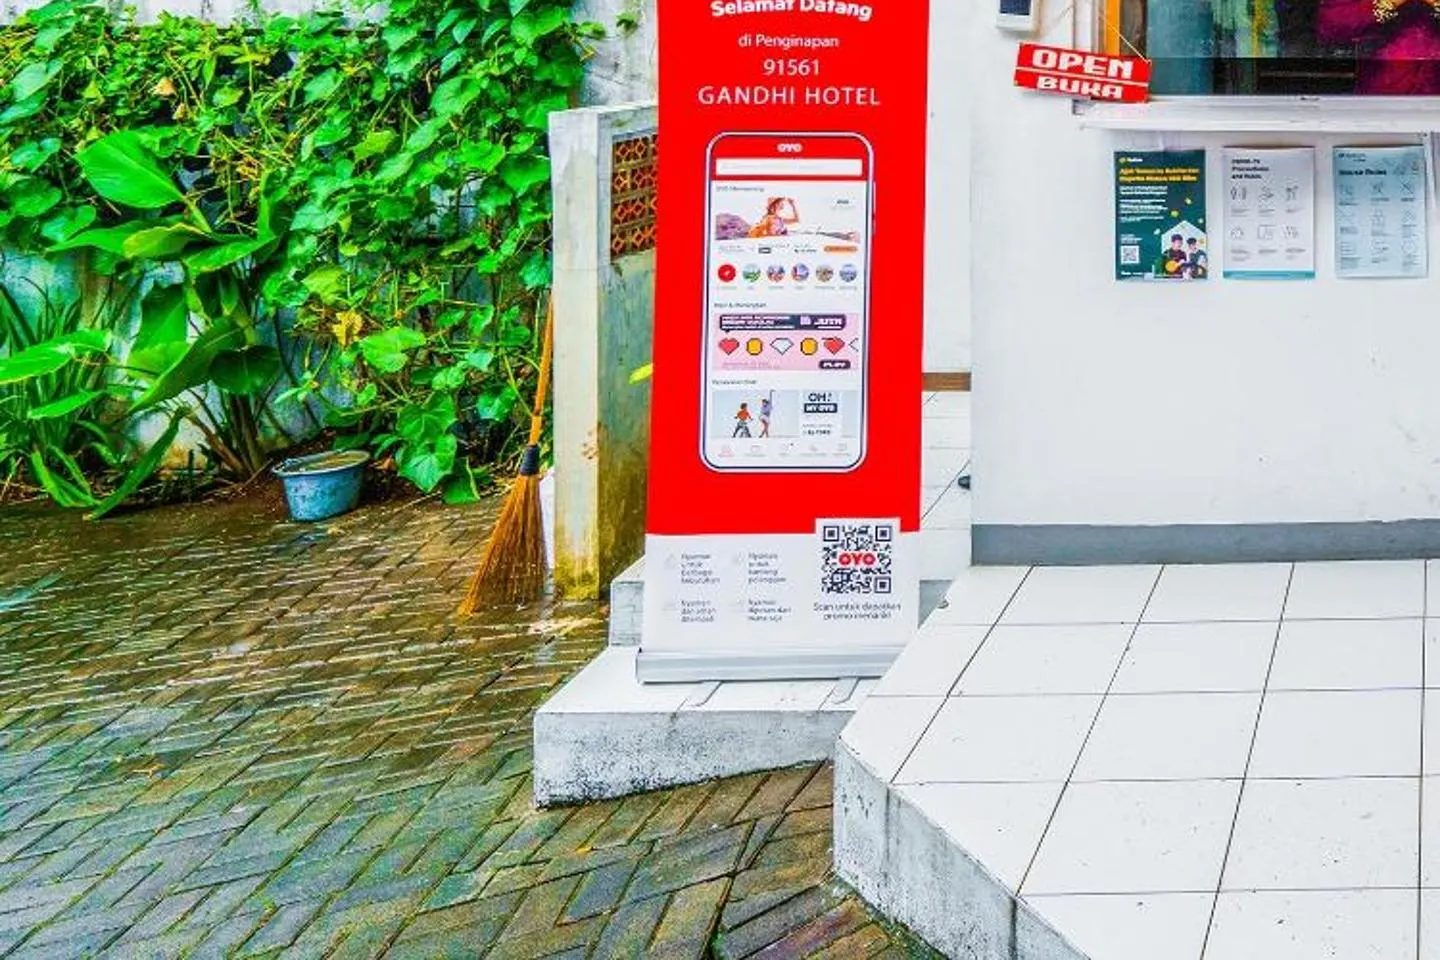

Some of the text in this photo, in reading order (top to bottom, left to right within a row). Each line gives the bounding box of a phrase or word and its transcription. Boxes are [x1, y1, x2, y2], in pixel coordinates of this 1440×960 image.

[738, 34, 839, 48] di Penginapan
[763, 59, 820, 76] 91561
[1031, 48, 1134, 80] OPEN
[698, 85, 881, 106] GANDHI HOTEL
[1036, 75, 1124, 99] BUKA
[777, 142, 803, 153] OYO
[838, 552, 877, 566] OYO
